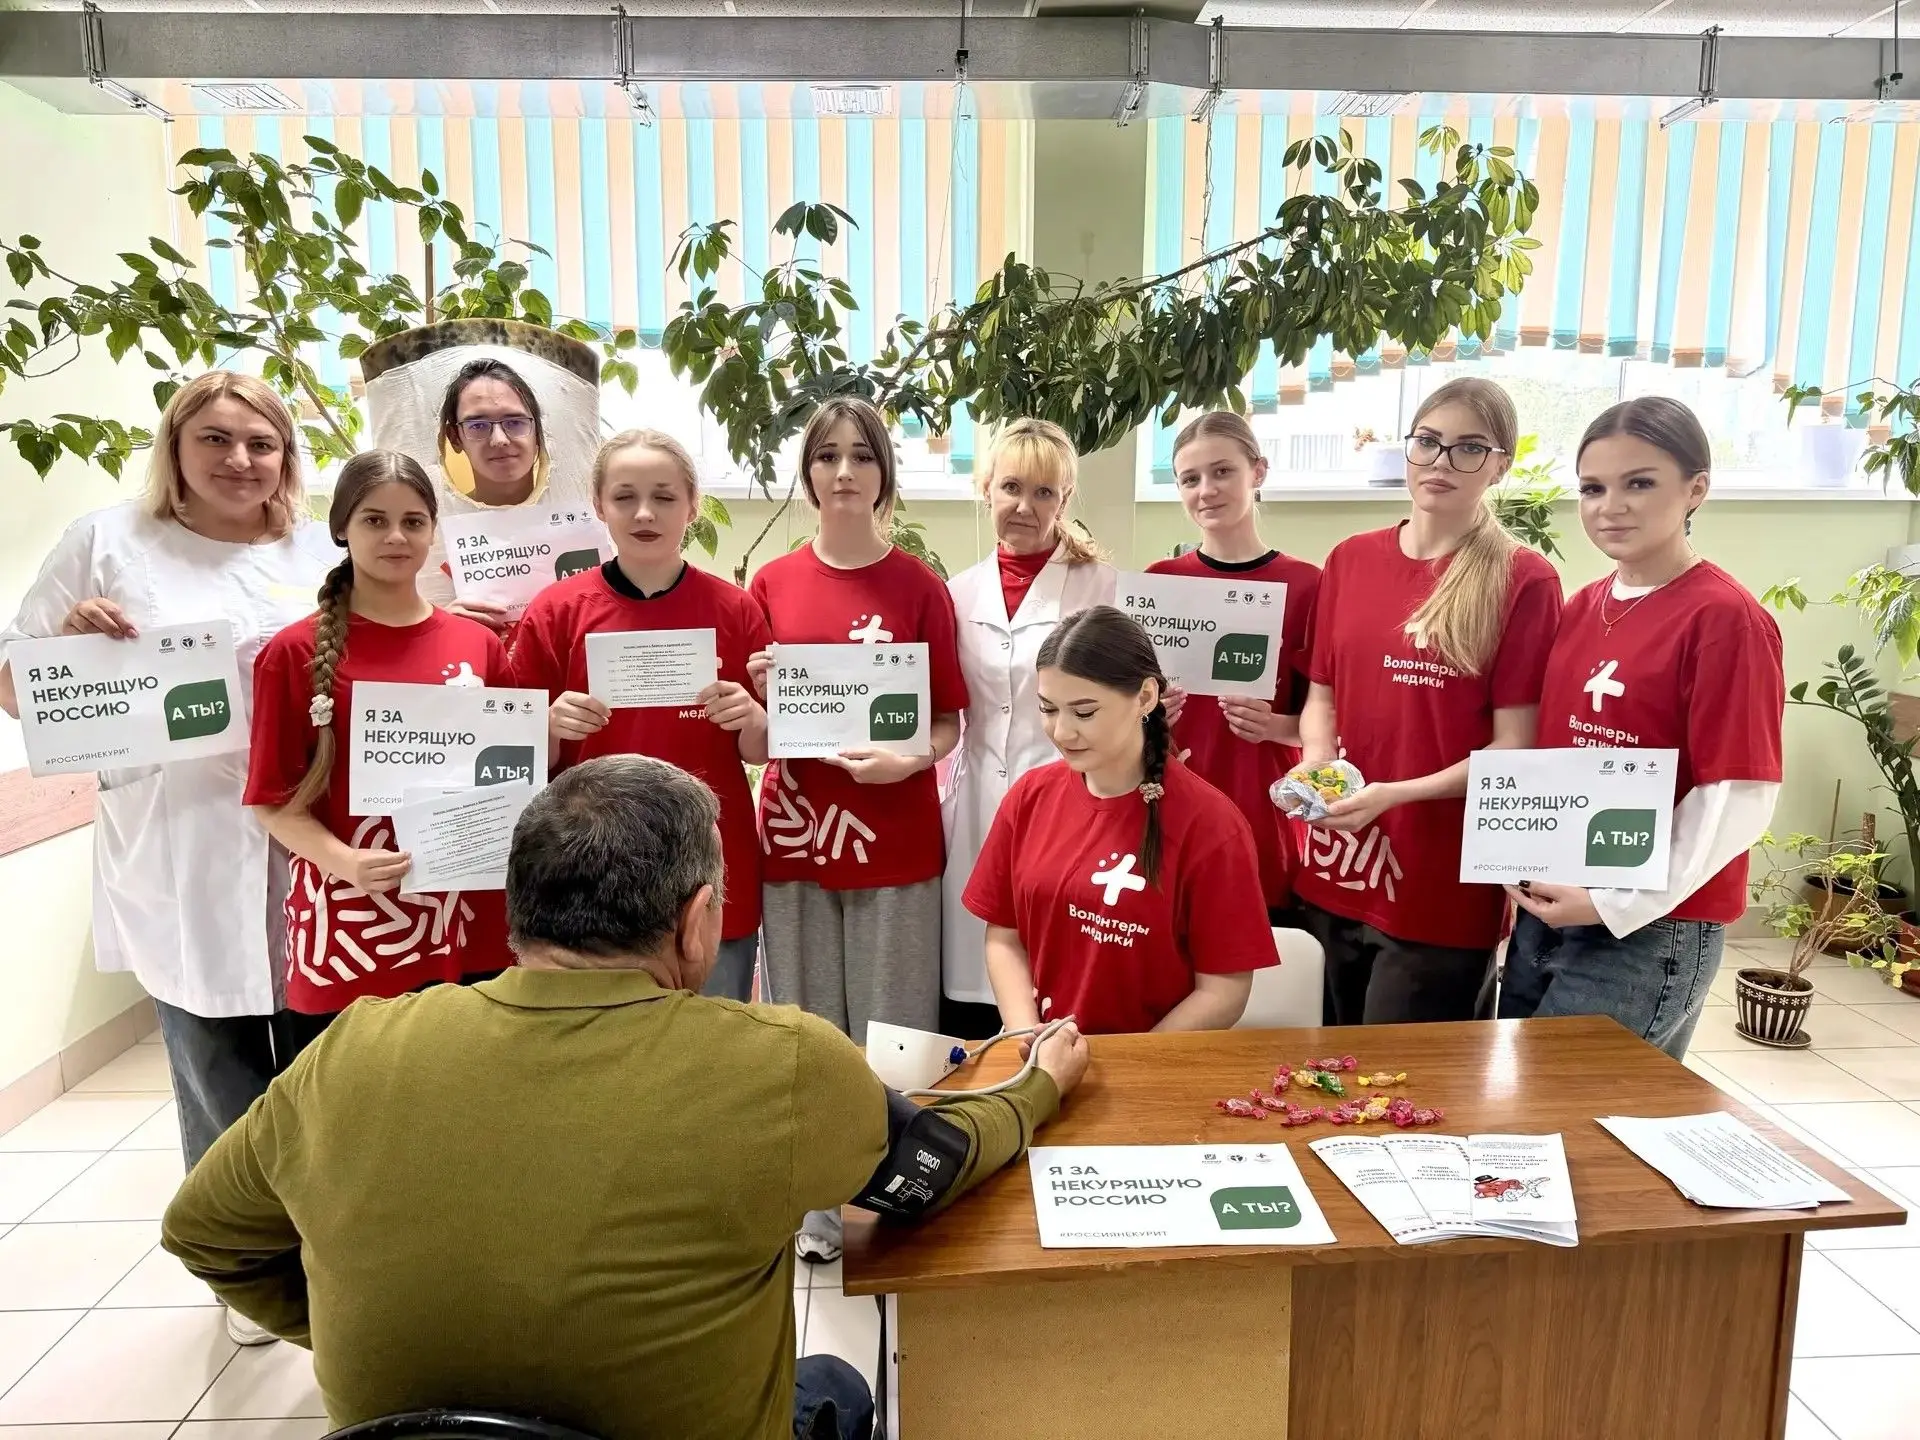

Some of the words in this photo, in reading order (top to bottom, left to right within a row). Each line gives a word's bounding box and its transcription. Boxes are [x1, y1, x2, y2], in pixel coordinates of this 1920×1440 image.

[457, 538, 466, 549] Я
[469, 535, 489, 548] ЗА
[460, 543, 551, 566] НЕКУРЯЩУЮ
[464, 563, 531, 583] РОССИЮ
[1125, 595, 1134, 607] Я
[1138, 597, 1156, 609] ЗА
[1218, 651, 1229, 664] А
[1233, 652, 1263, 665] ТЫ?
[28, 668, 41, 682] Я
[47, 665, 74, 680] ЗА
[778, 668, 787, 679] Я
[791, 667, 809, 679] ЗА
[1383, 655, 1459, 678] Волонтеры
[1392, 672, 1444, 689] медики
[33, 676, 159, 703] НЕКУРЯЩУЮ
[778, 683, 869, 697] НЕКУРЯЩУЮ
[37, 701, 130, 724] РОССИЮ
[172, 706, 186, 721] А
[189, 701, 225, 719] ТЫ?
[679, 709, 709, 720] мед
[779, 701, 845, 714] РОССИЮ
[365, 709, 376, 723] Я
[381, 710, 404, 723] ЗА
[874, 712, 884, 724] А
[887, 712, 915, 724] ТЫ?
[364, 730, 476, 747] НЕКУРЯЩУЮ
[45, 747, 130, 766] #РОССИЯНЕКУРИТ
[364, 750, 446, 765] РОССИЮ
[480, 766, 492, 779] А
[1481, 777, 1491, 790] Я
[1495, 776, 1517, 790] ЗА
[1479, 795, 1589, 812] НЕКУРЯЩУЮ
[1477, 817, 1558, 831] РОССИЮ
[1592, 831, 1606, 845] А
[1611, 831, 1650, 846] ТЫ?
[1473, 864, 1549, 873] #РОССИЯНЕКУРИТ
[1068, 903, 1150, 936] Волонтеры
[1081, 924, 1134, 948] медики
[1049, 1166, 1062, 1175] Я
[1070, 1166, 1100, 1176] ЗА
[1051, 1178, 1203, 1192] НЕКУРЯЩУЮ
[1054, 1194, 1167, 1206] РОССИЮ
[1221, 1203, 1240, 1214] А
[1243, 1202, 1291, 1214] ТЫ?
[1060, 1230, 1168, 1238] #РОССИЯНЕКУРИТ
